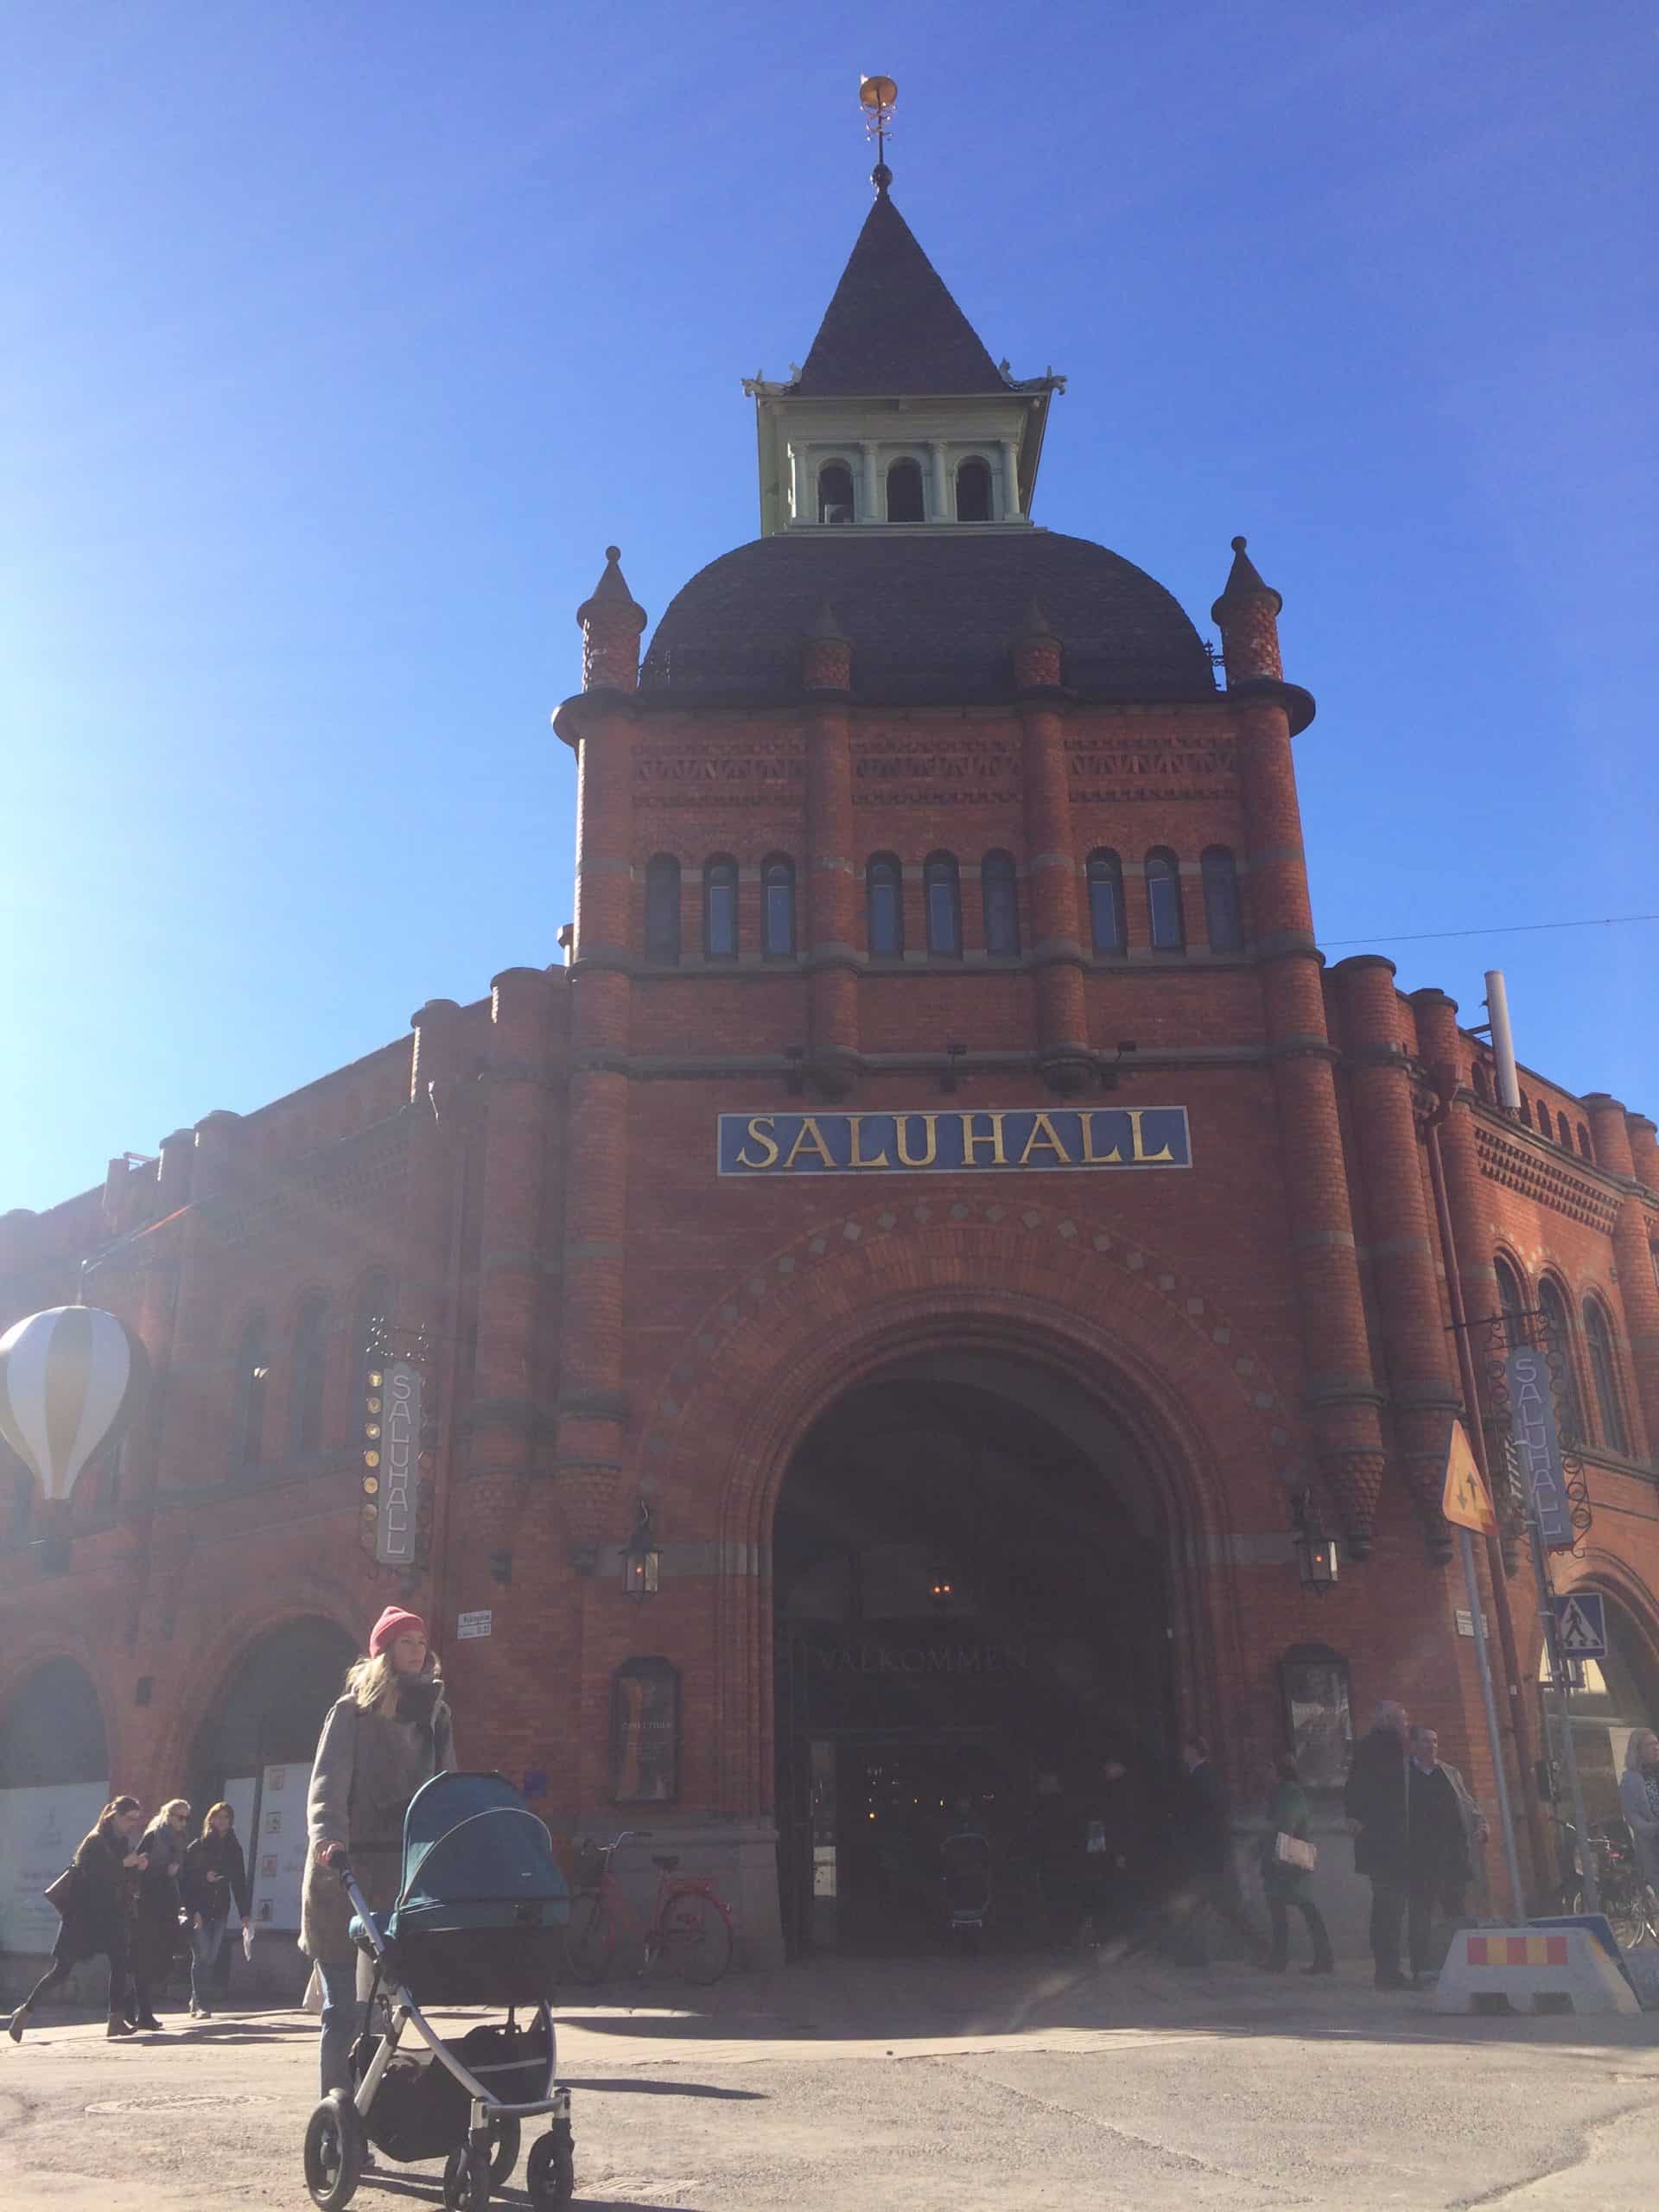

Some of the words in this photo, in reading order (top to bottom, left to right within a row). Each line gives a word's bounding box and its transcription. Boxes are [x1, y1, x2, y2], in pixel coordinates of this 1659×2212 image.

[735, 1111, 1174, 1168] SALUHALL
[387, 1375, 412, 1554] SALUHALL
[1515, 1359, 1562, 1536] SALUHALL
